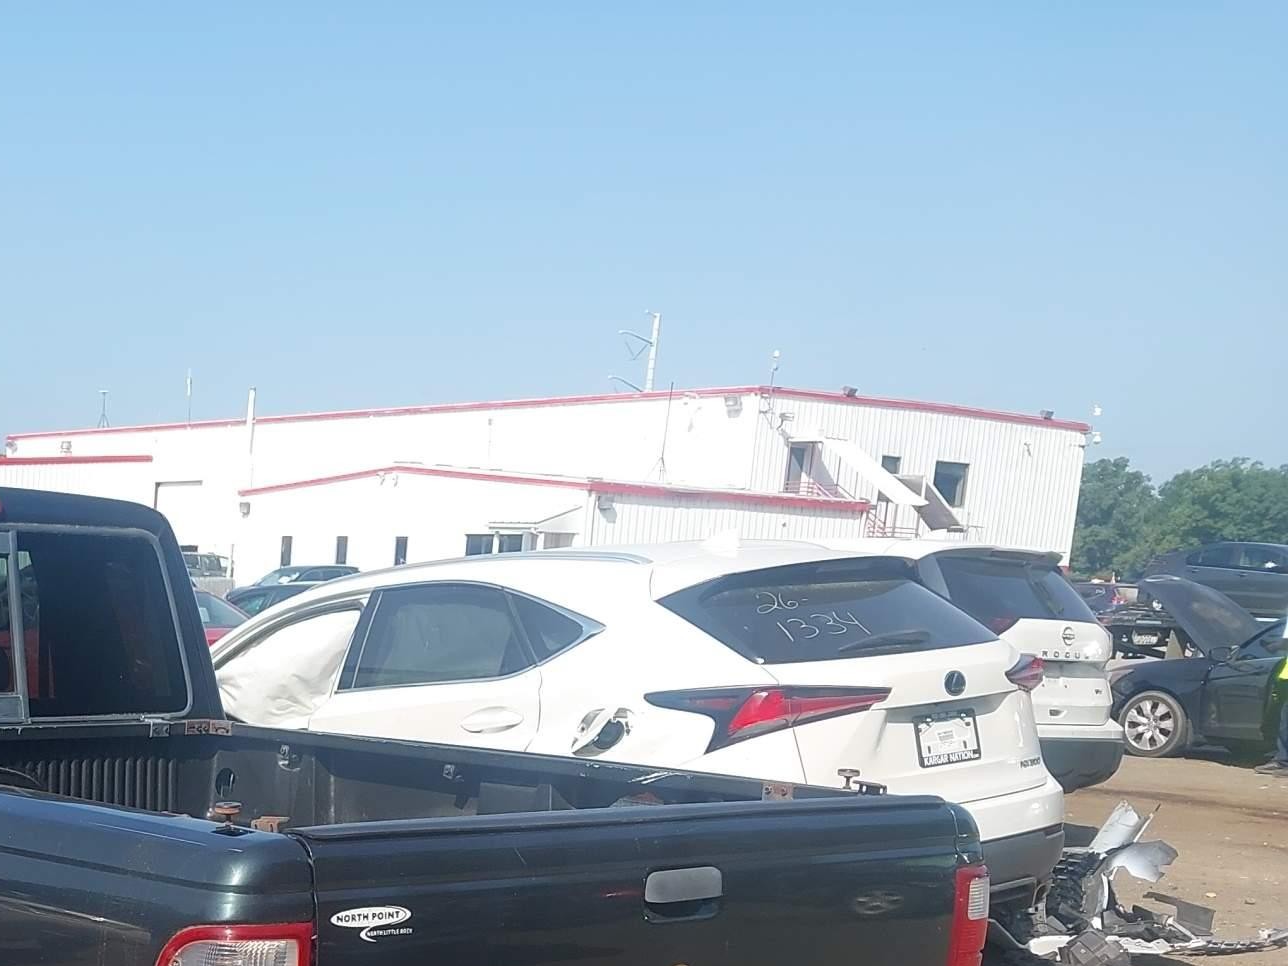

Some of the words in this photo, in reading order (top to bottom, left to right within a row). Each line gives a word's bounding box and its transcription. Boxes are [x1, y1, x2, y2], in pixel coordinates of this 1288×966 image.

[756, 591, 809, 614] 26-
[776, 611, 872, 642] 1334
[336, 912, 369, 923] NORTH
[372, 910, 401, 920] POINT
[383, 928, 400, 936] LITTLE
